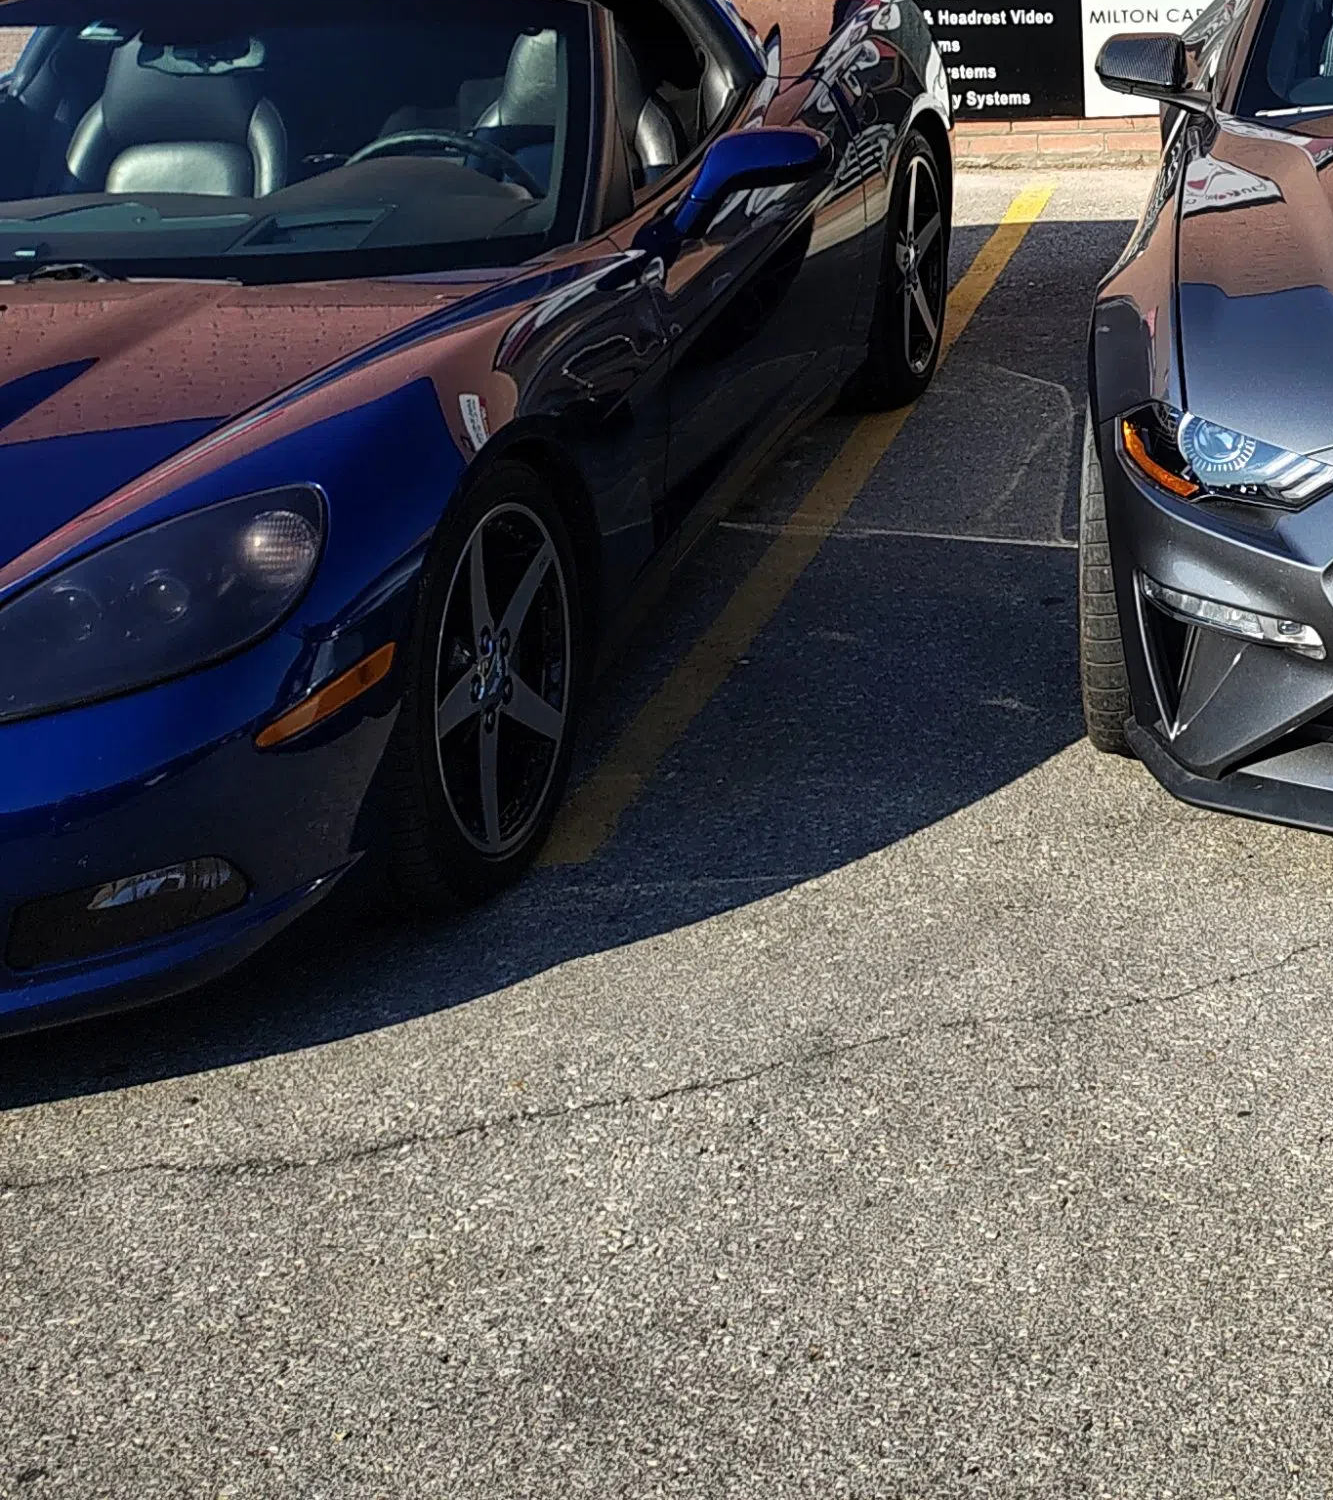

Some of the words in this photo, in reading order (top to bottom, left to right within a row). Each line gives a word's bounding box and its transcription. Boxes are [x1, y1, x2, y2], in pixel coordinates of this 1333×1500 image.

[937, 10, 1007, 25] Headrest
[1009, 9, 1054, 25] Video
[1089, 9, 1159, 23] MILTON
[947, 65, 997, 79] stems
[966, 90, 1031, 110] Systems
